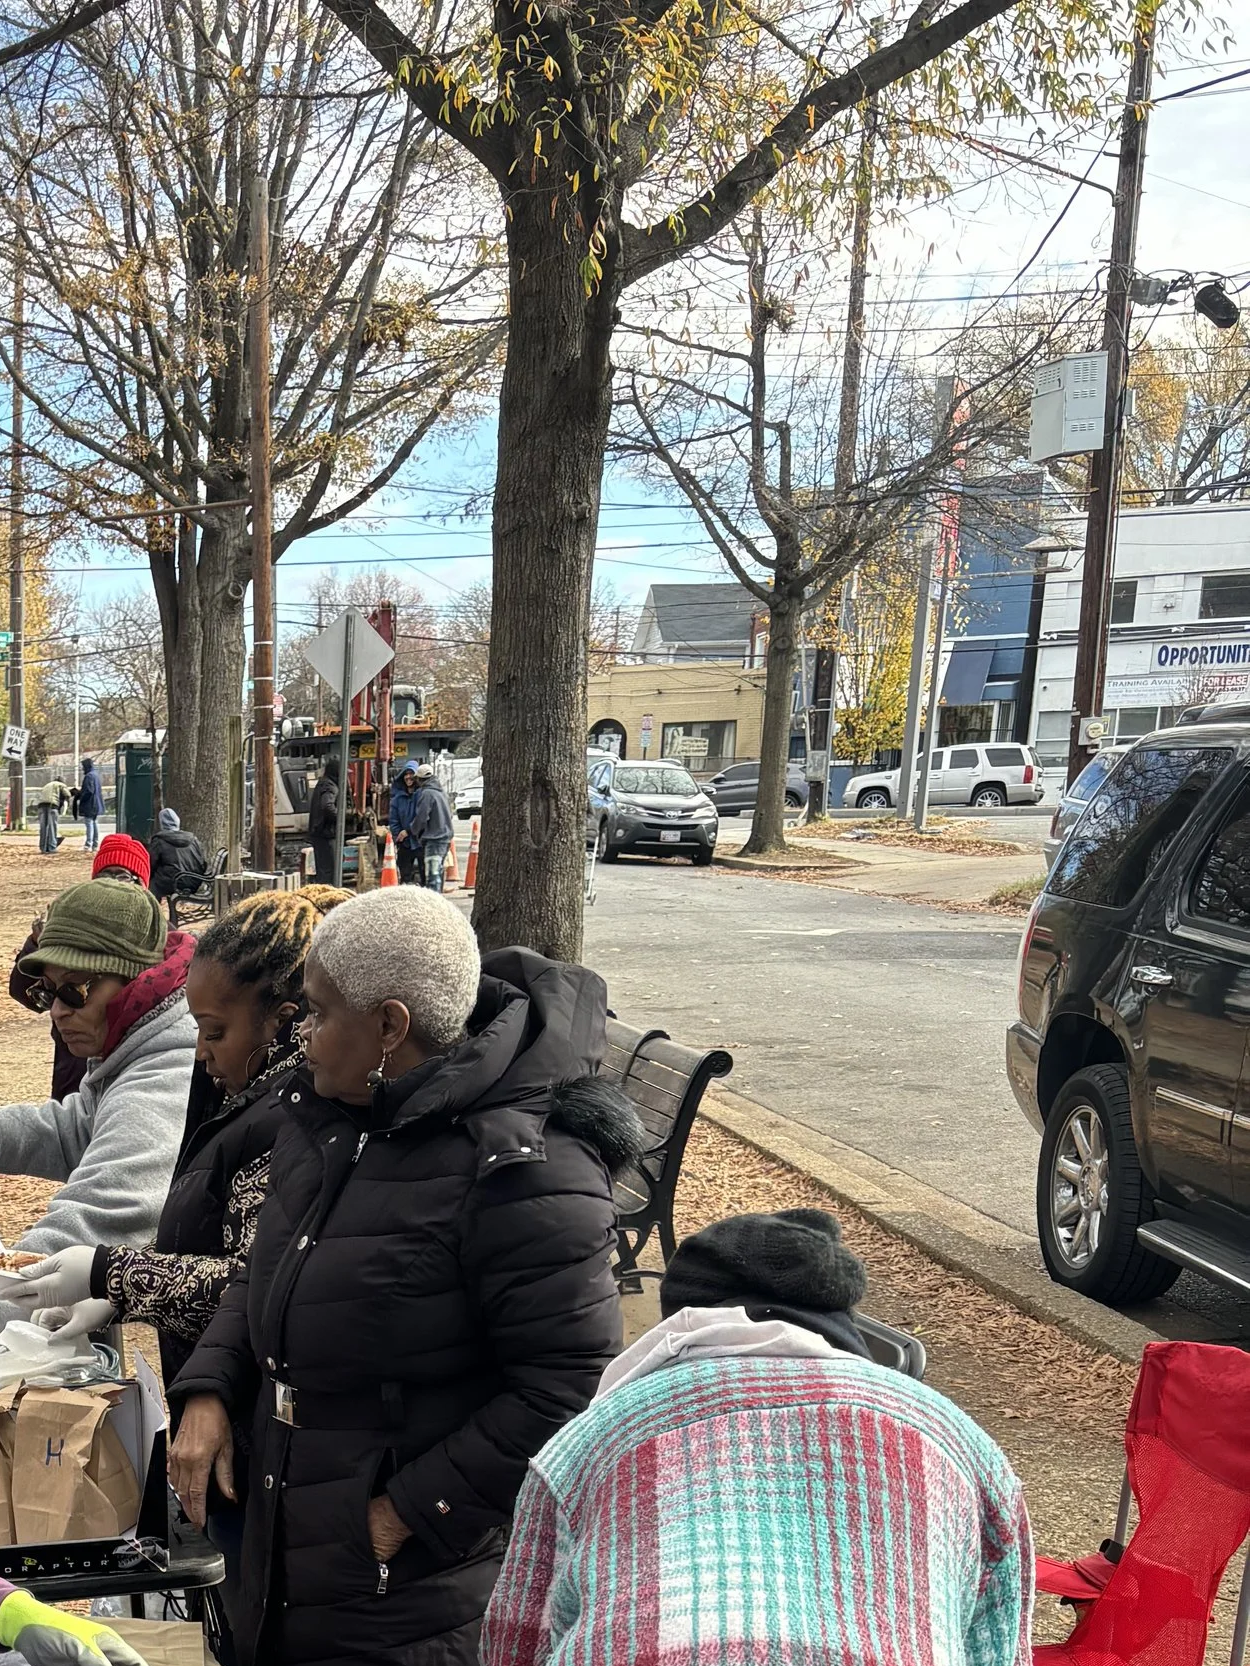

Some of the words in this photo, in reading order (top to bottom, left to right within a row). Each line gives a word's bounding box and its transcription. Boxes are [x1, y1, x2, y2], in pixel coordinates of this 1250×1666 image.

[1157, 644, 1250, 666] OPPORTUNIT
[1107, 679, 1150, 688] TRAINING
[1203, 677, 1219, 686] FOR
[1223, 675, 1248, 686] LEASE
[9, 728, 26, 739] ONE
[7, 736, 25, 747] WAY
[45, 1436, 65, 1467] H
